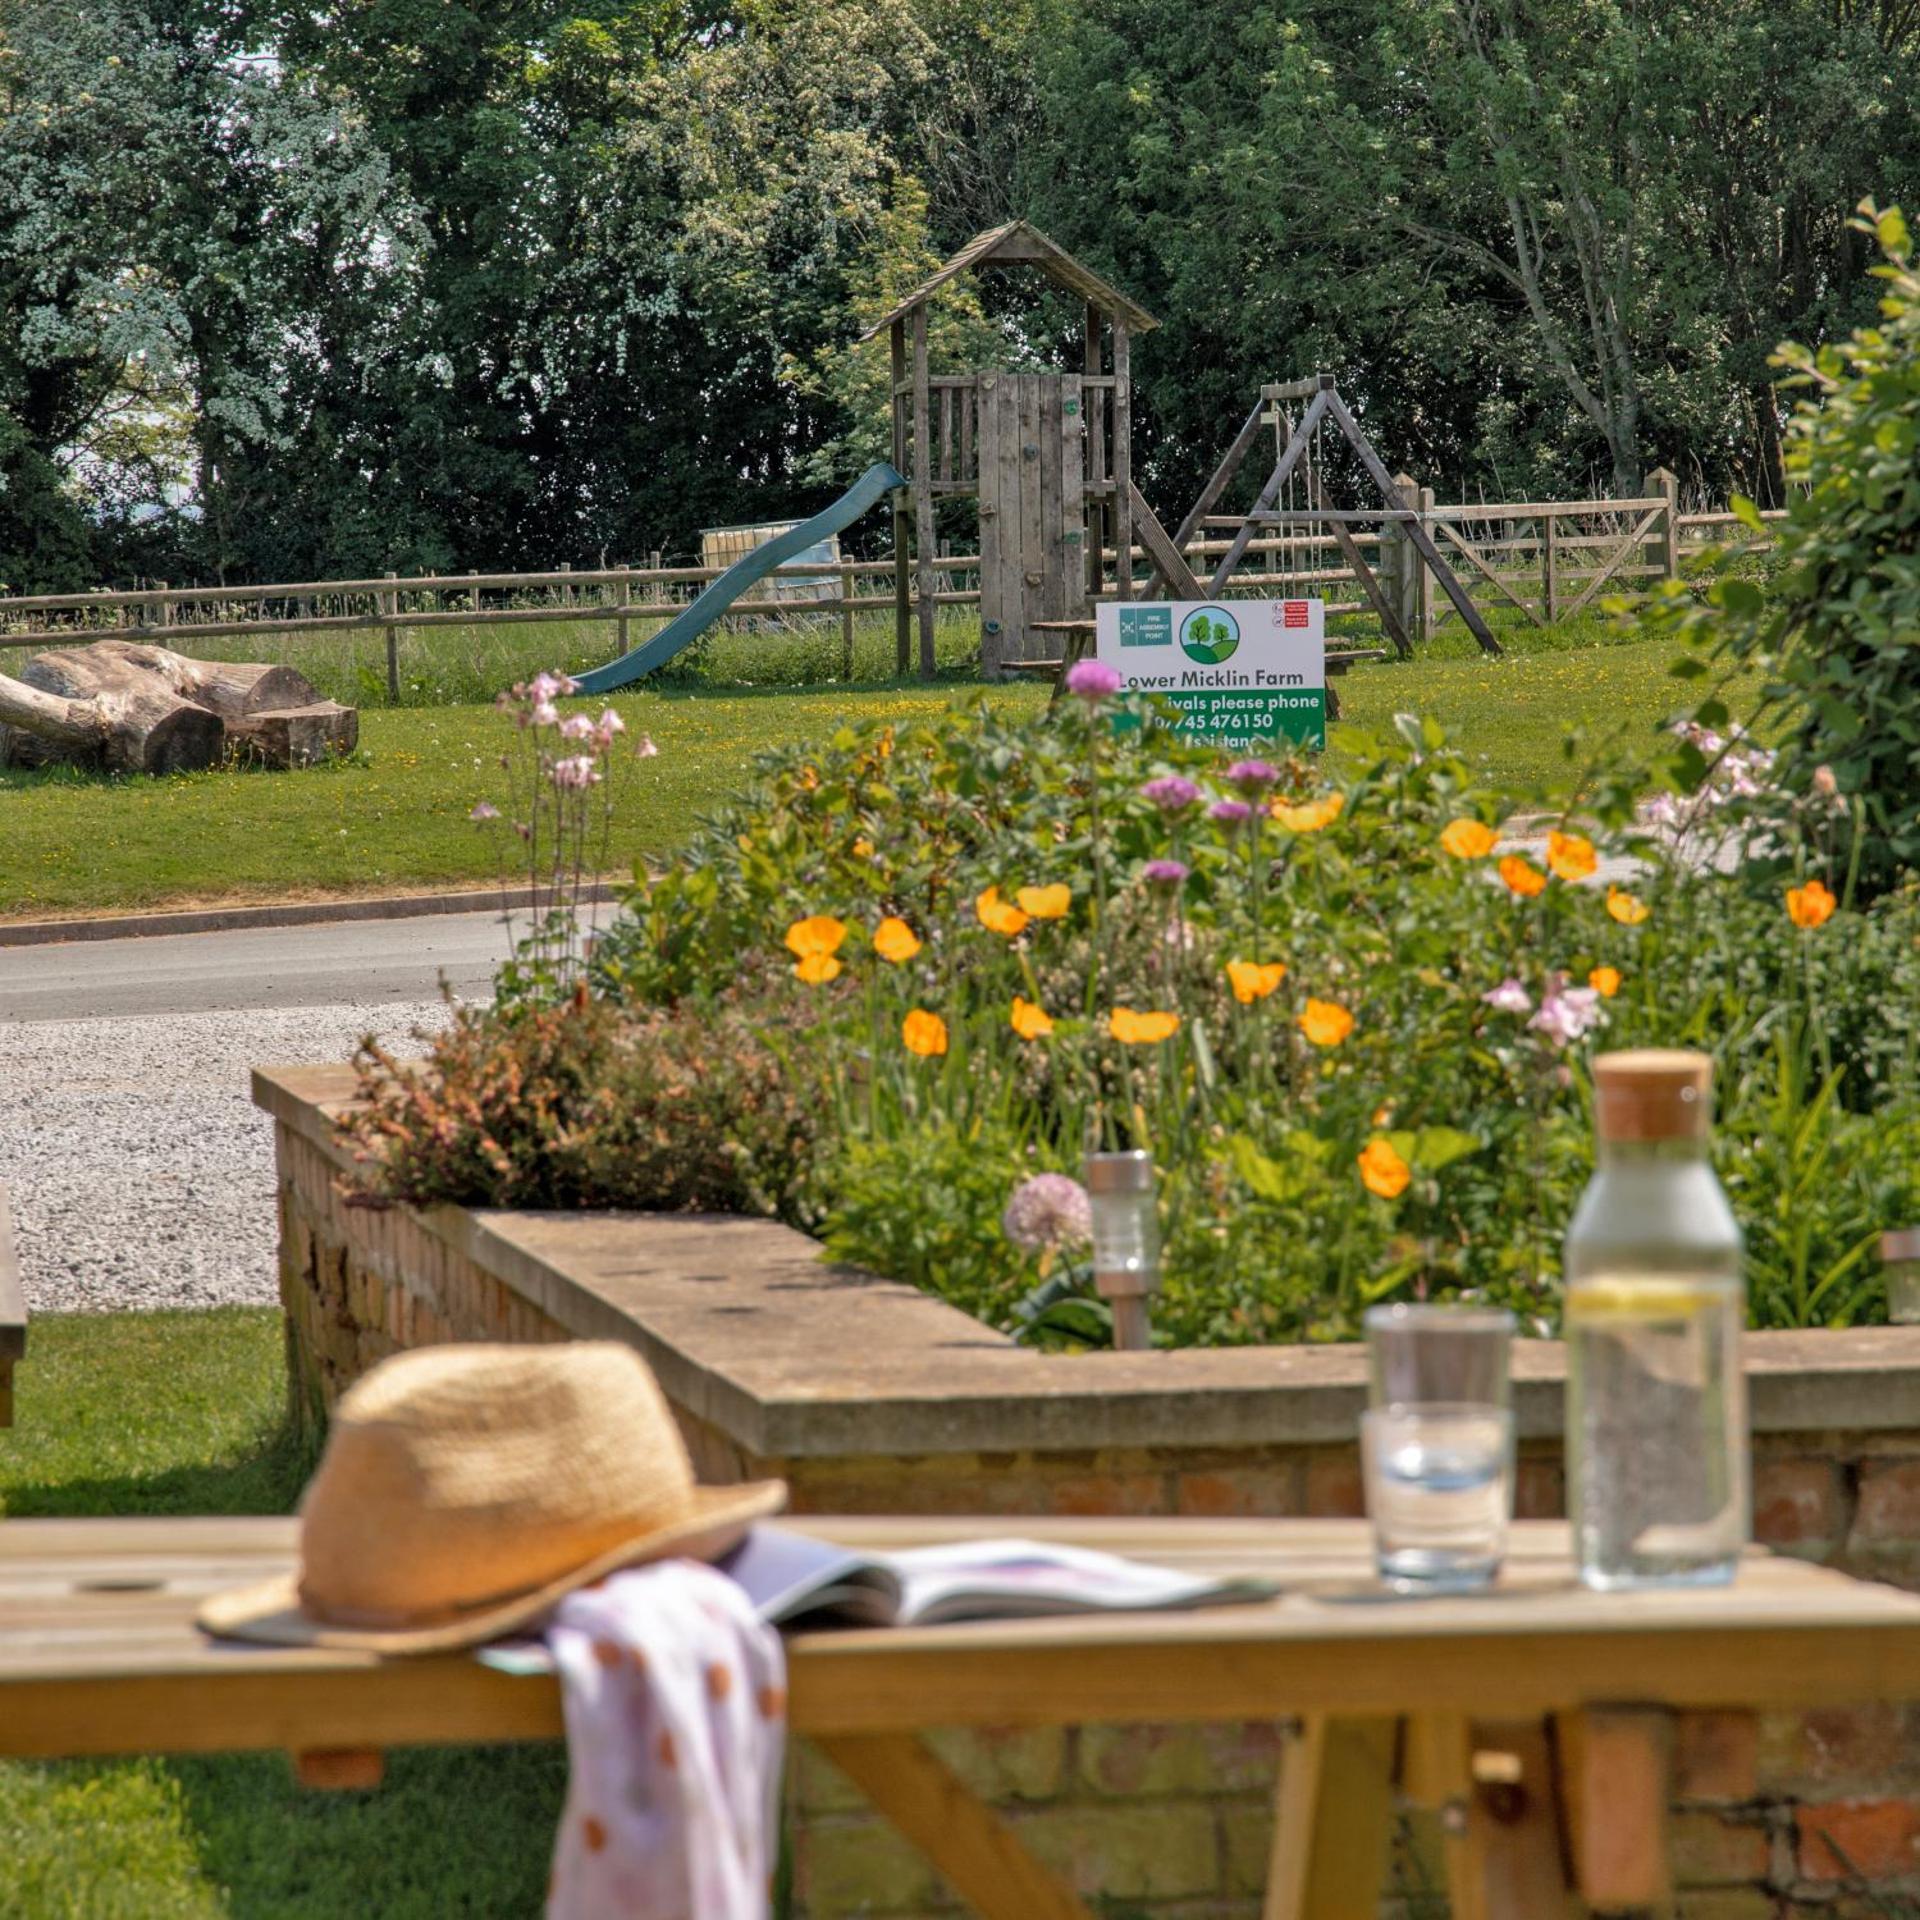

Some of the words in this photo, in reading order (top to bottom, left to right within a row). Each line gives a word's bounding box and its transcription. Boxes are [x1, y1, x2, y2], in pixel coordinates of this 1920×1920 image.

[1118, 671, 1176, 688] Lower
[1181, 669, 1250, 687] Micklin
[1256, 669, 1304, 686] Farm
[1211, 694, 1264, 713] please
[1268, 694, 1320, 711] phone
[1210, 713, 1273, 729] 476150
